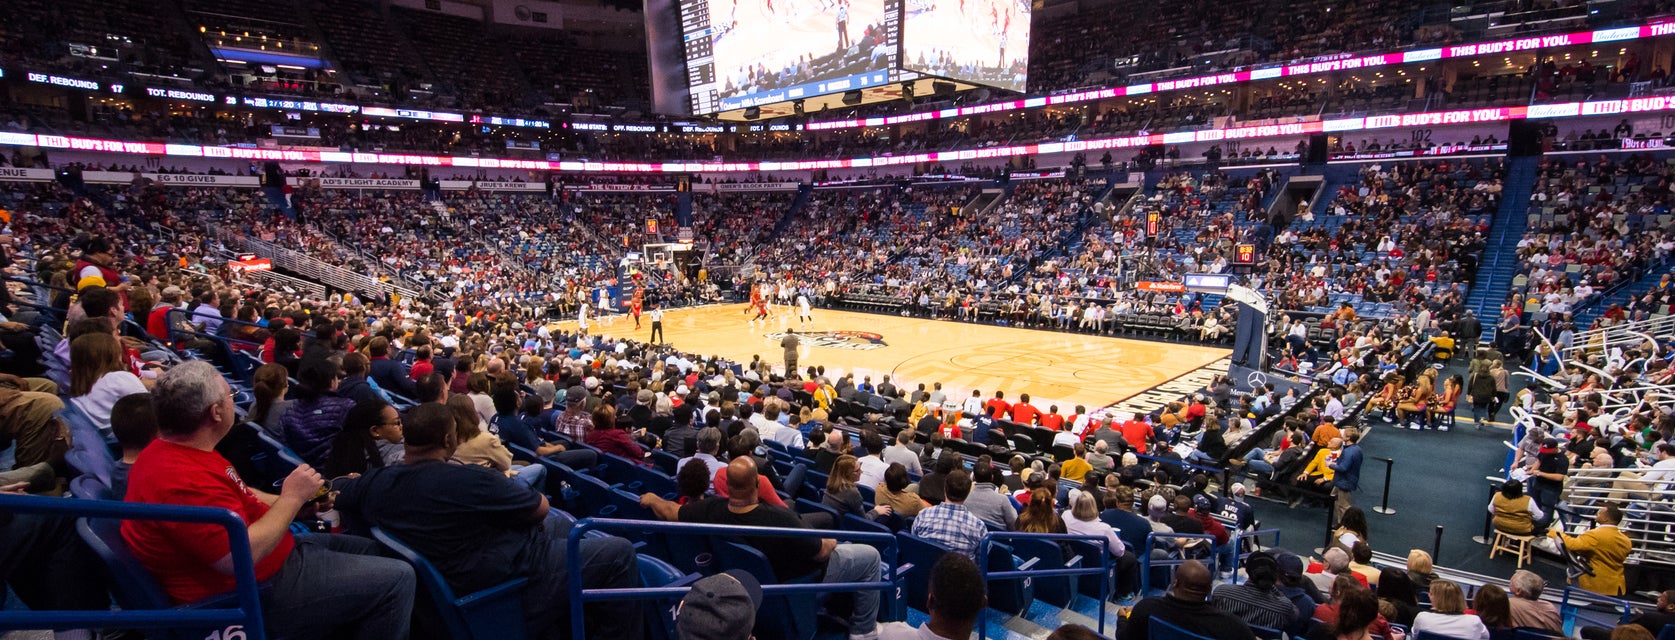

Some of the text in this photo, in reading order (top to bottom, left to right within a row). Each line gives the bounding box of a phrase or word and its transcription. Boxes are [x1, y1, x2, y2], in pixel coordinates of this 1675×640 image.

[1450, 45, 1476, 57] THIS
[1478, 40, 1514, 54] BUD'S
[1516, 38, 1541, 50] FOR
[1288, 65, 1310, 76] THIS
[1311, 61, 1340, 72] BUD'S
[1342, 58, 1362, 70] FOR
[28, 73, 99, 90] DEF. REBOUNDS
[1157, 81, 1174, 91] THIS
[1176, 78, 1200, 89] BUD'S
[1200, 75, 1217, 86] FOR
[111, 84, 124, 93] 17
[147, 88, 215, 102] TOT. REBOUNDS
[741, 96, 755, 107] NBA
[754, 92, 784, 105] Scoreboard
[1050, 96, 1064, 105] THIS
[1065, 94, 1085, 103] BUD'S
[1086, 91, 1100, 100] FOR
[974, 104, 990, 114] BUD'S
[991, 103, 1002, 112] FOR
[1594, 100, 1628, 115] THIS
[1402, 112, 1442, 126] BUD'S
[1443, 110, 1471, 123] FOR
[1225, 126, 1257, 138] BUD'S
[1258, 125, 1280, 136] FOR
[1411, 130, 1432, 142] 102
[46, 136, 70, 148] THIS
[71, 138, 103, 150] BUD'S
[104, 141, 124, 152] FOR
[1087, 138, 1112, 149] BUD'S
[1112, 138, 1130, 148] FOR
[1226, 140, 1240, 152] 101
[232, 150, 262, 159] BUD'S
[262, 150, 282, 160] FOR
[379, 154, 405, 164] BUD'S
[405, 156, 422, 164] FOR
[978, 148, 998, 158] BUD'S
[998, 148, 1010, 156] FOR
[146, 157, 160, 168] 117
[157, 174, 170, 182] EG
[504, 182, 527, 190] KREWE
